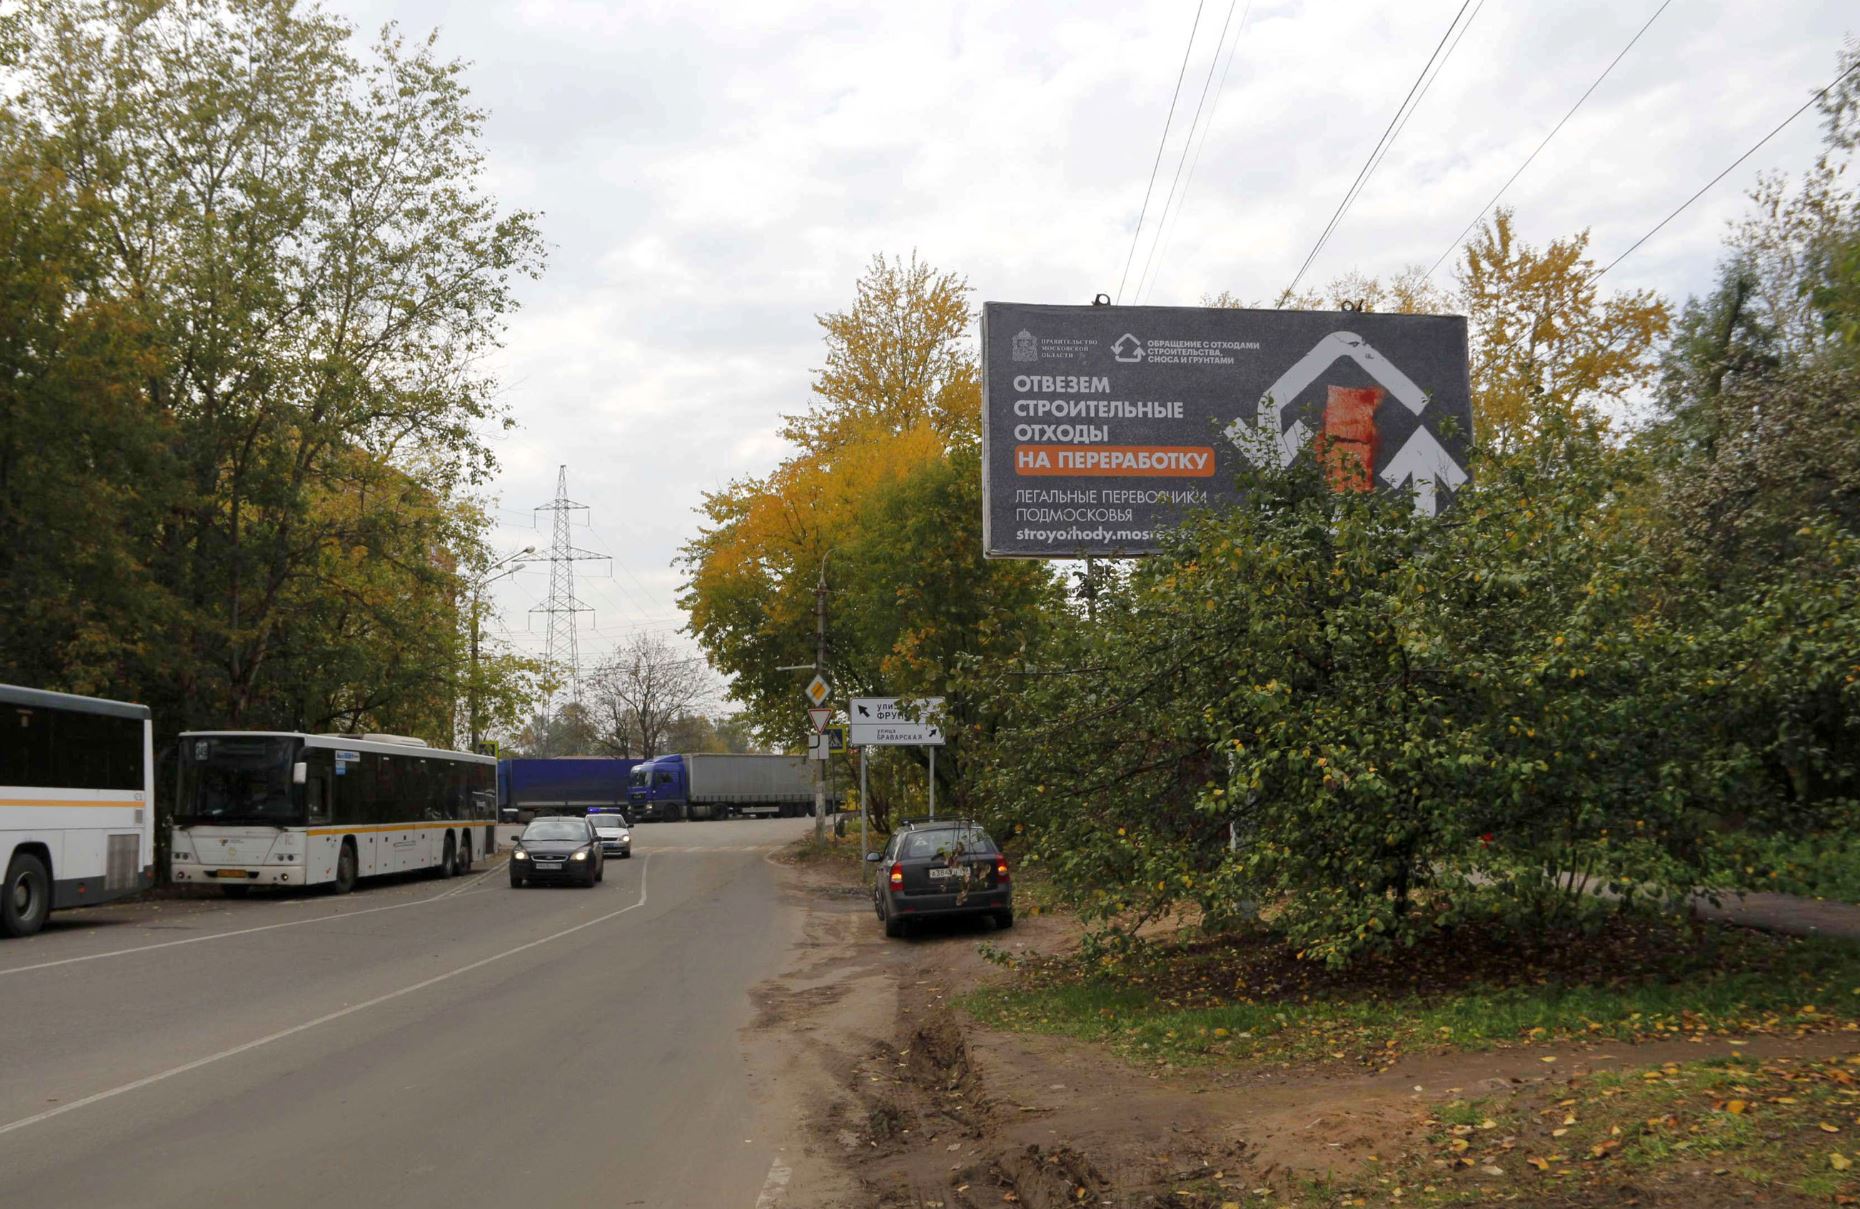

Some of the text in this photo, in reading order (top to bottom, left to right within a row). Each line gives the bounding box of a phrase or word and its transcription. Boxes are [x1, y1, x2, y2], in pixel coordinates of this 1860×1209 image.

[1147, 340, 1260, 350] ОБРАЩЕНИЕ С ОТХОДАМИ
[1147, 356, 1235, 365] СНОСА И ГРУНТАМИ
[1013, 375, 1110, 393] ОТВЕЗЕМ
[1013, 400, 1184, 418] СТРОИТЕЛЬНЫЕ
[1014, 424, 1109, 444] ОТХОДЫ
[1018, 452, 1208, 470] НА ПЕРЕРАБОТКУ
[1016, 489, 1097, 503] ЛЕГАЛЬНЫЕ
[1016, 508, 1133, 523] ПОДМОСКОВЬЯ
